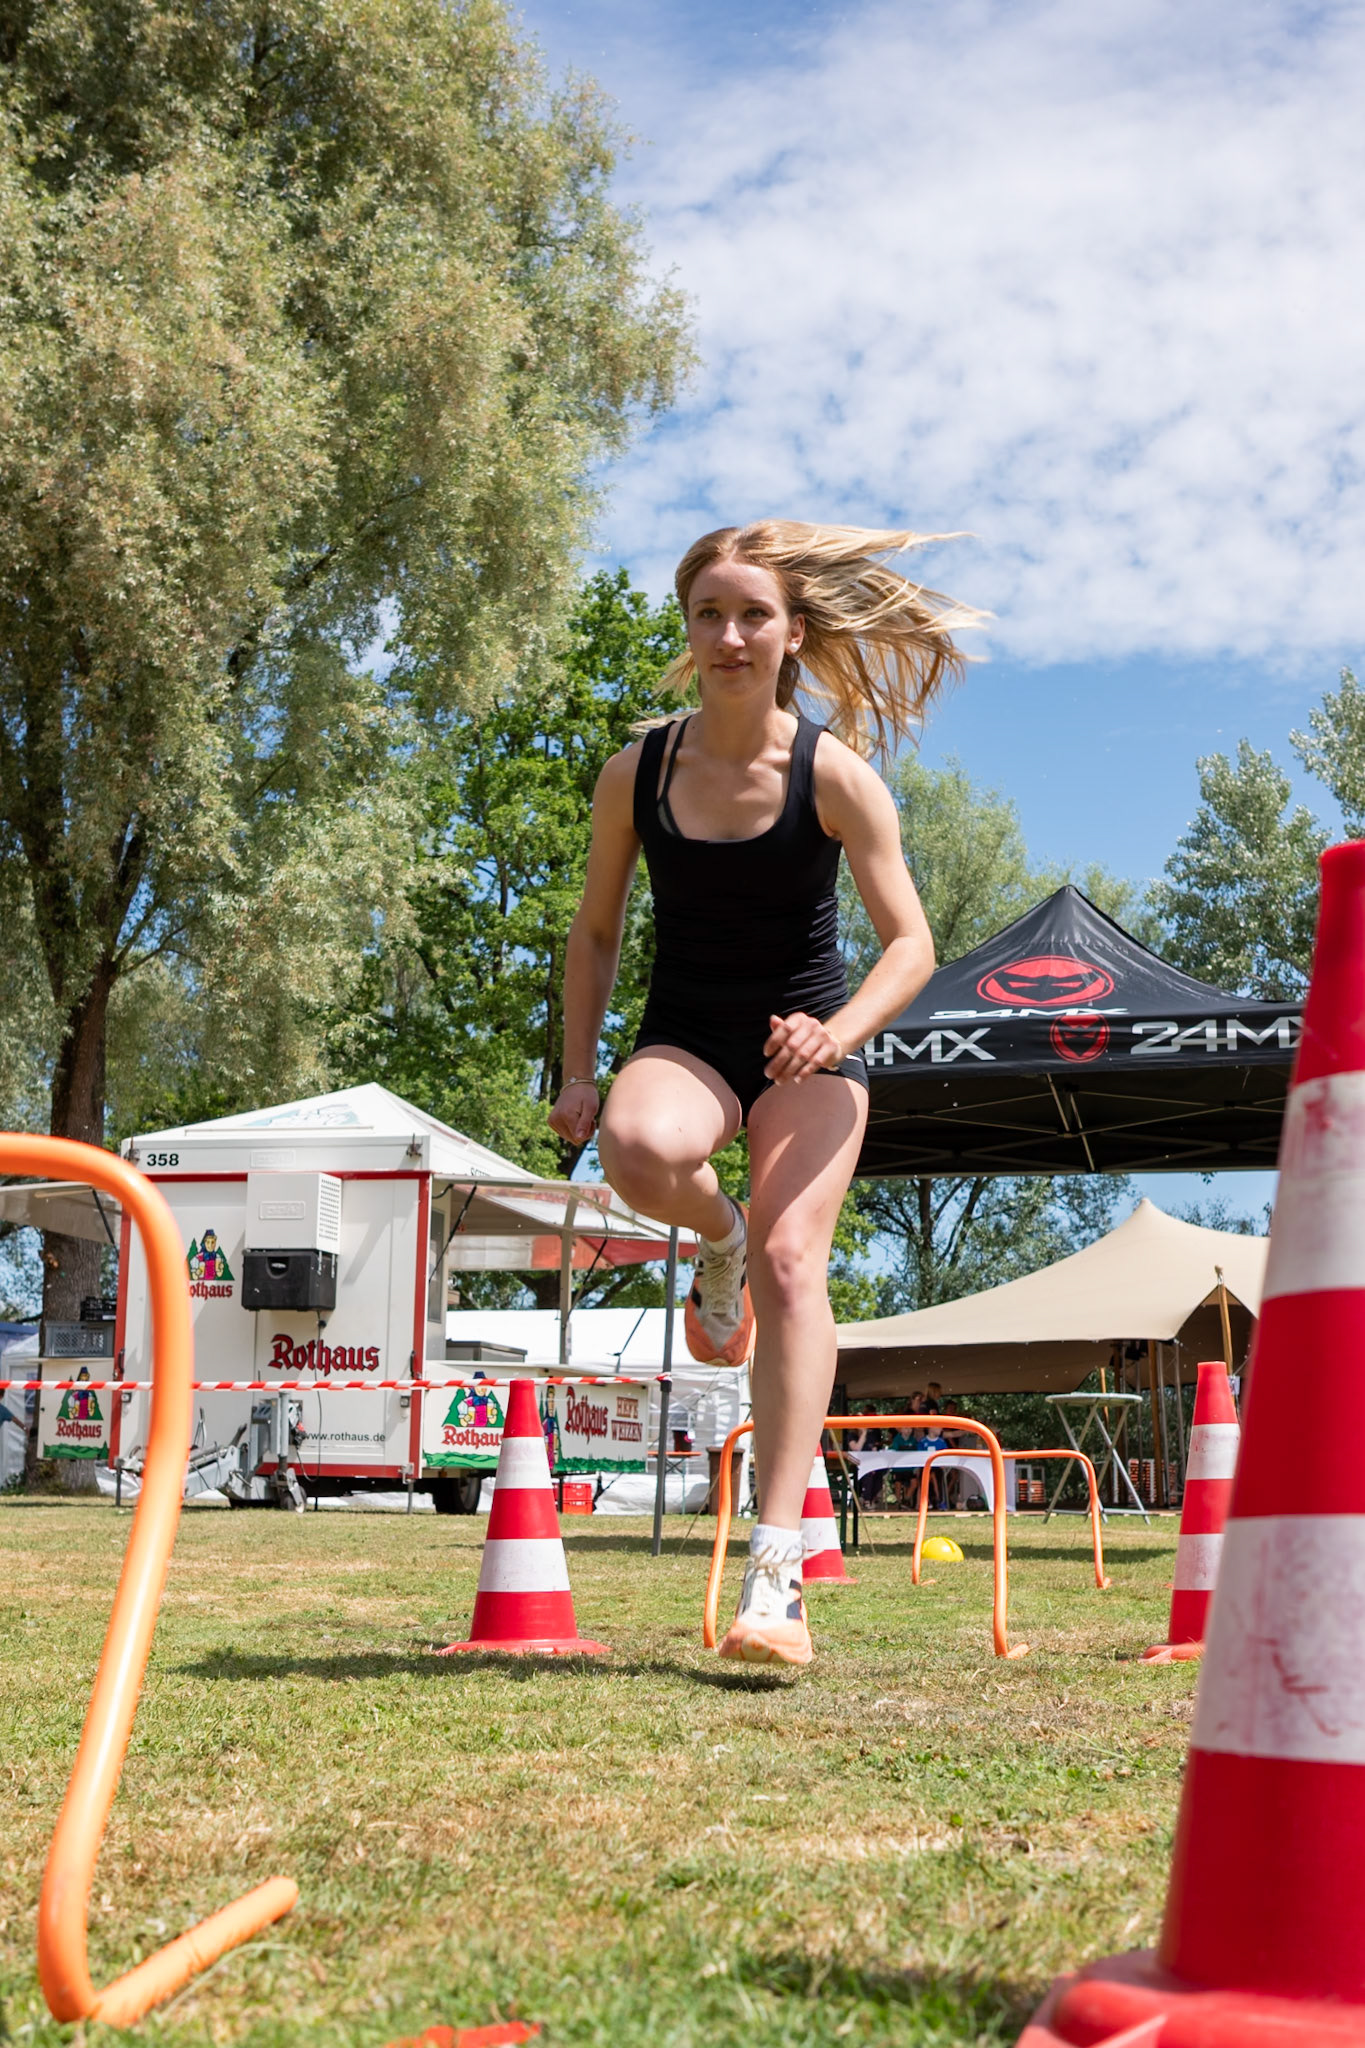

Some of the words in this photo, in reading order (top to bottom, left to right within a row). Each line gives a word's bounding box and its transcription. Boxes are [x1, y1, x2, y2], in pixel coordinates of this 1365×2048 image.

[929, 1008, 1130, 1020] 24MX
[863, 1028, 997, 1066] MX
[147, 1153, 180, 1167] 358
[189, 1282, 234, 1300] othaus
[268, 1334, 381, 1377] Rothaus
[565, 1385, 608, 1445] Rothaus
[56, 1418, 102, 1440] Rothaus
